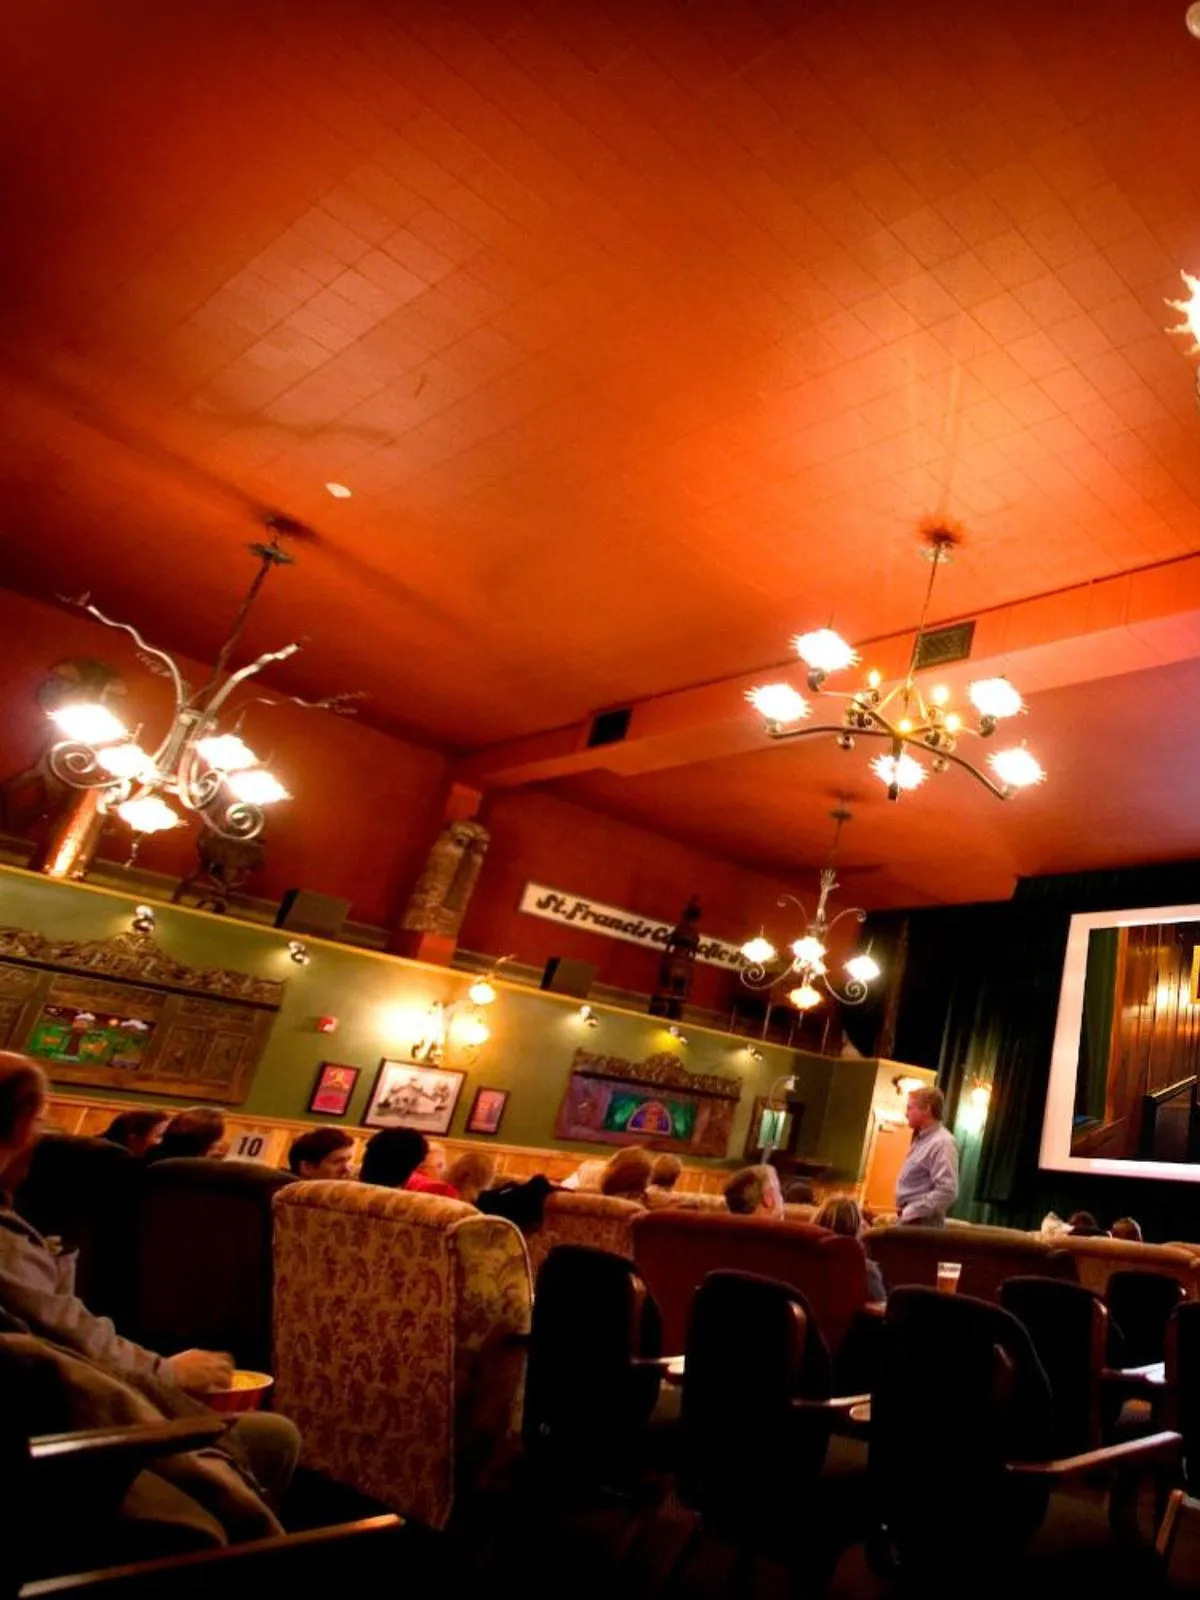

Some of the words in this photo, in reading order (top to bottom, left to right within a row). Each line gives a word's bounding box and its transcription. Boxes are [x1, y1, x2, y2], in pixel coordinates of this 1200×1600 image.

[535, 894, 567, 915] St.
[564, 902, 653, 938] Francis
[650, 926, 730, 962] Colic
[237, 1136, 264, 1157] 10
